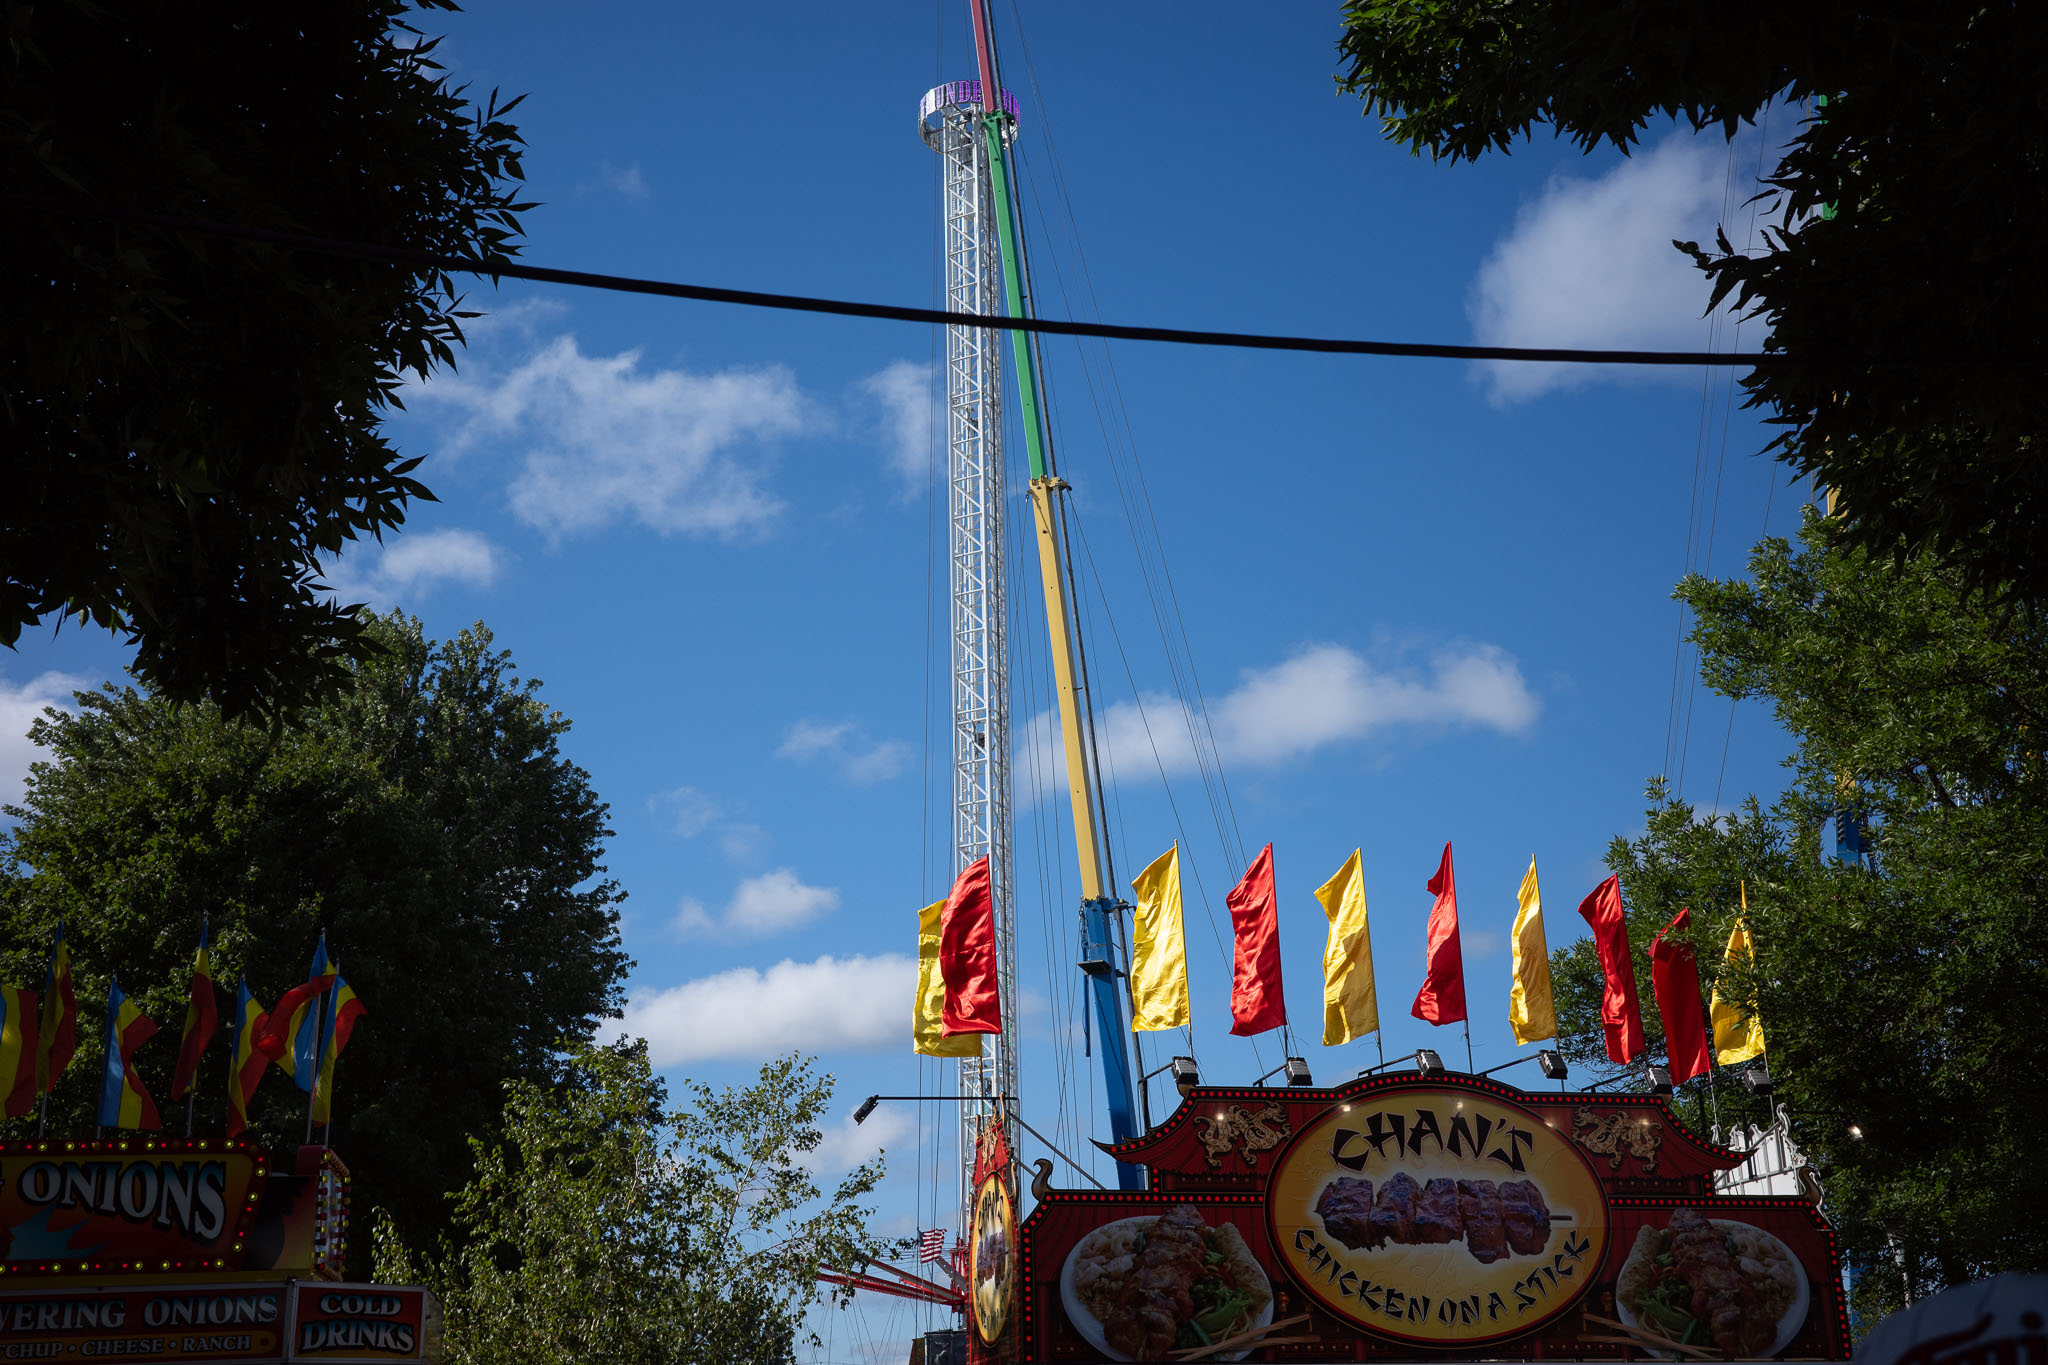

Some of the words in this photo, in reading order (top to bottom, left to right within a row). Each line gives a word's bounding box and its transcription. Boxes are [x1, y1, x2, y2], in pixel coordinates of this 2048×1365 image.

[1328, 1108, 1534, 1173] CHAN'S
[18, 1160, 226, 1243] ONIONS
[1294, 1228, 1430, 1323] CHICKEN
[1438, 1295, 1482, 1326] ON
[1486, 1291, 1508, 1321] A
[1511, 1230, 1592, 1313] STICK
[143, 1294, 279, 1327] ONIONS
[319, 1294, 402, 1316] COLD
[81, 1338, 164, 1356] CHEESE
[182, 1335, 251, 1353] RANCH
[301, 1318, 415, 1354] DRINKS
